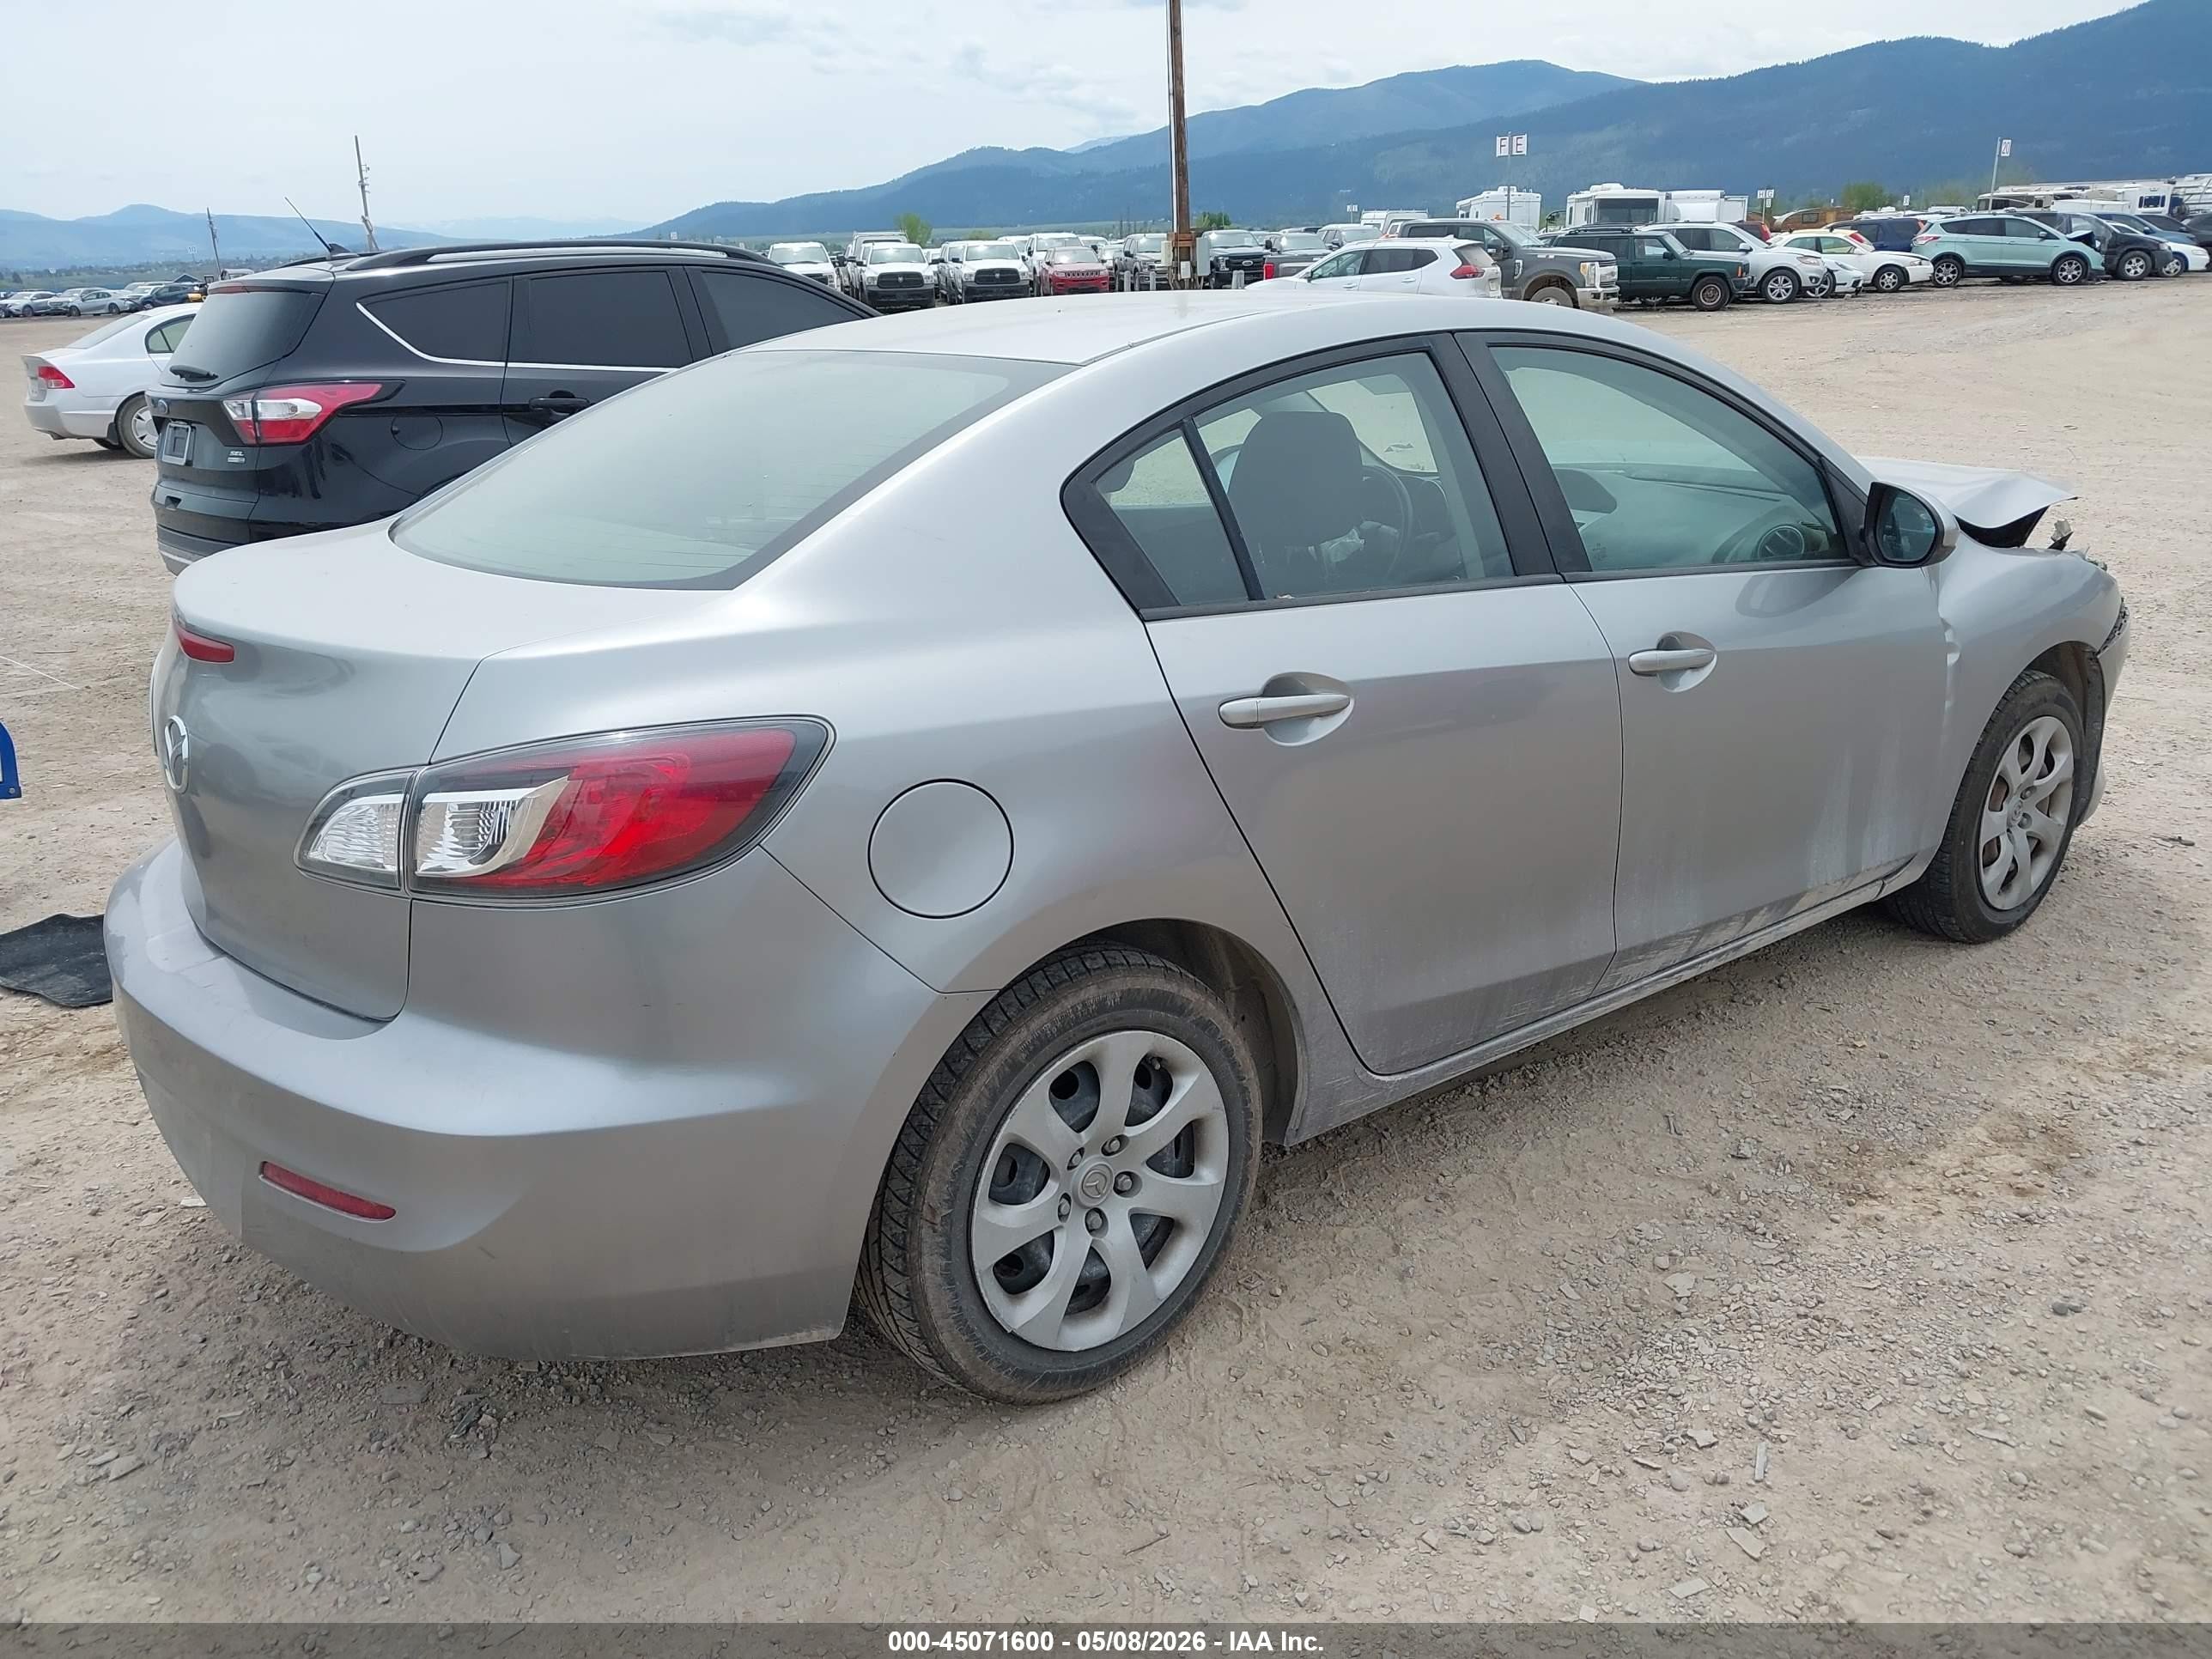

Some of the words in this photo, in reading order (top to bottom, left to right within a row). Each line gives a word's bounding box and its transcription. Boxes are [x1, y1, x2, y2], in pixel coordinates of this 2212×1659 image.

[1499, 137, 1507, 155] F
[1516, 137, 1523, 153] E
[2002, 141, 2011, 155] 20
